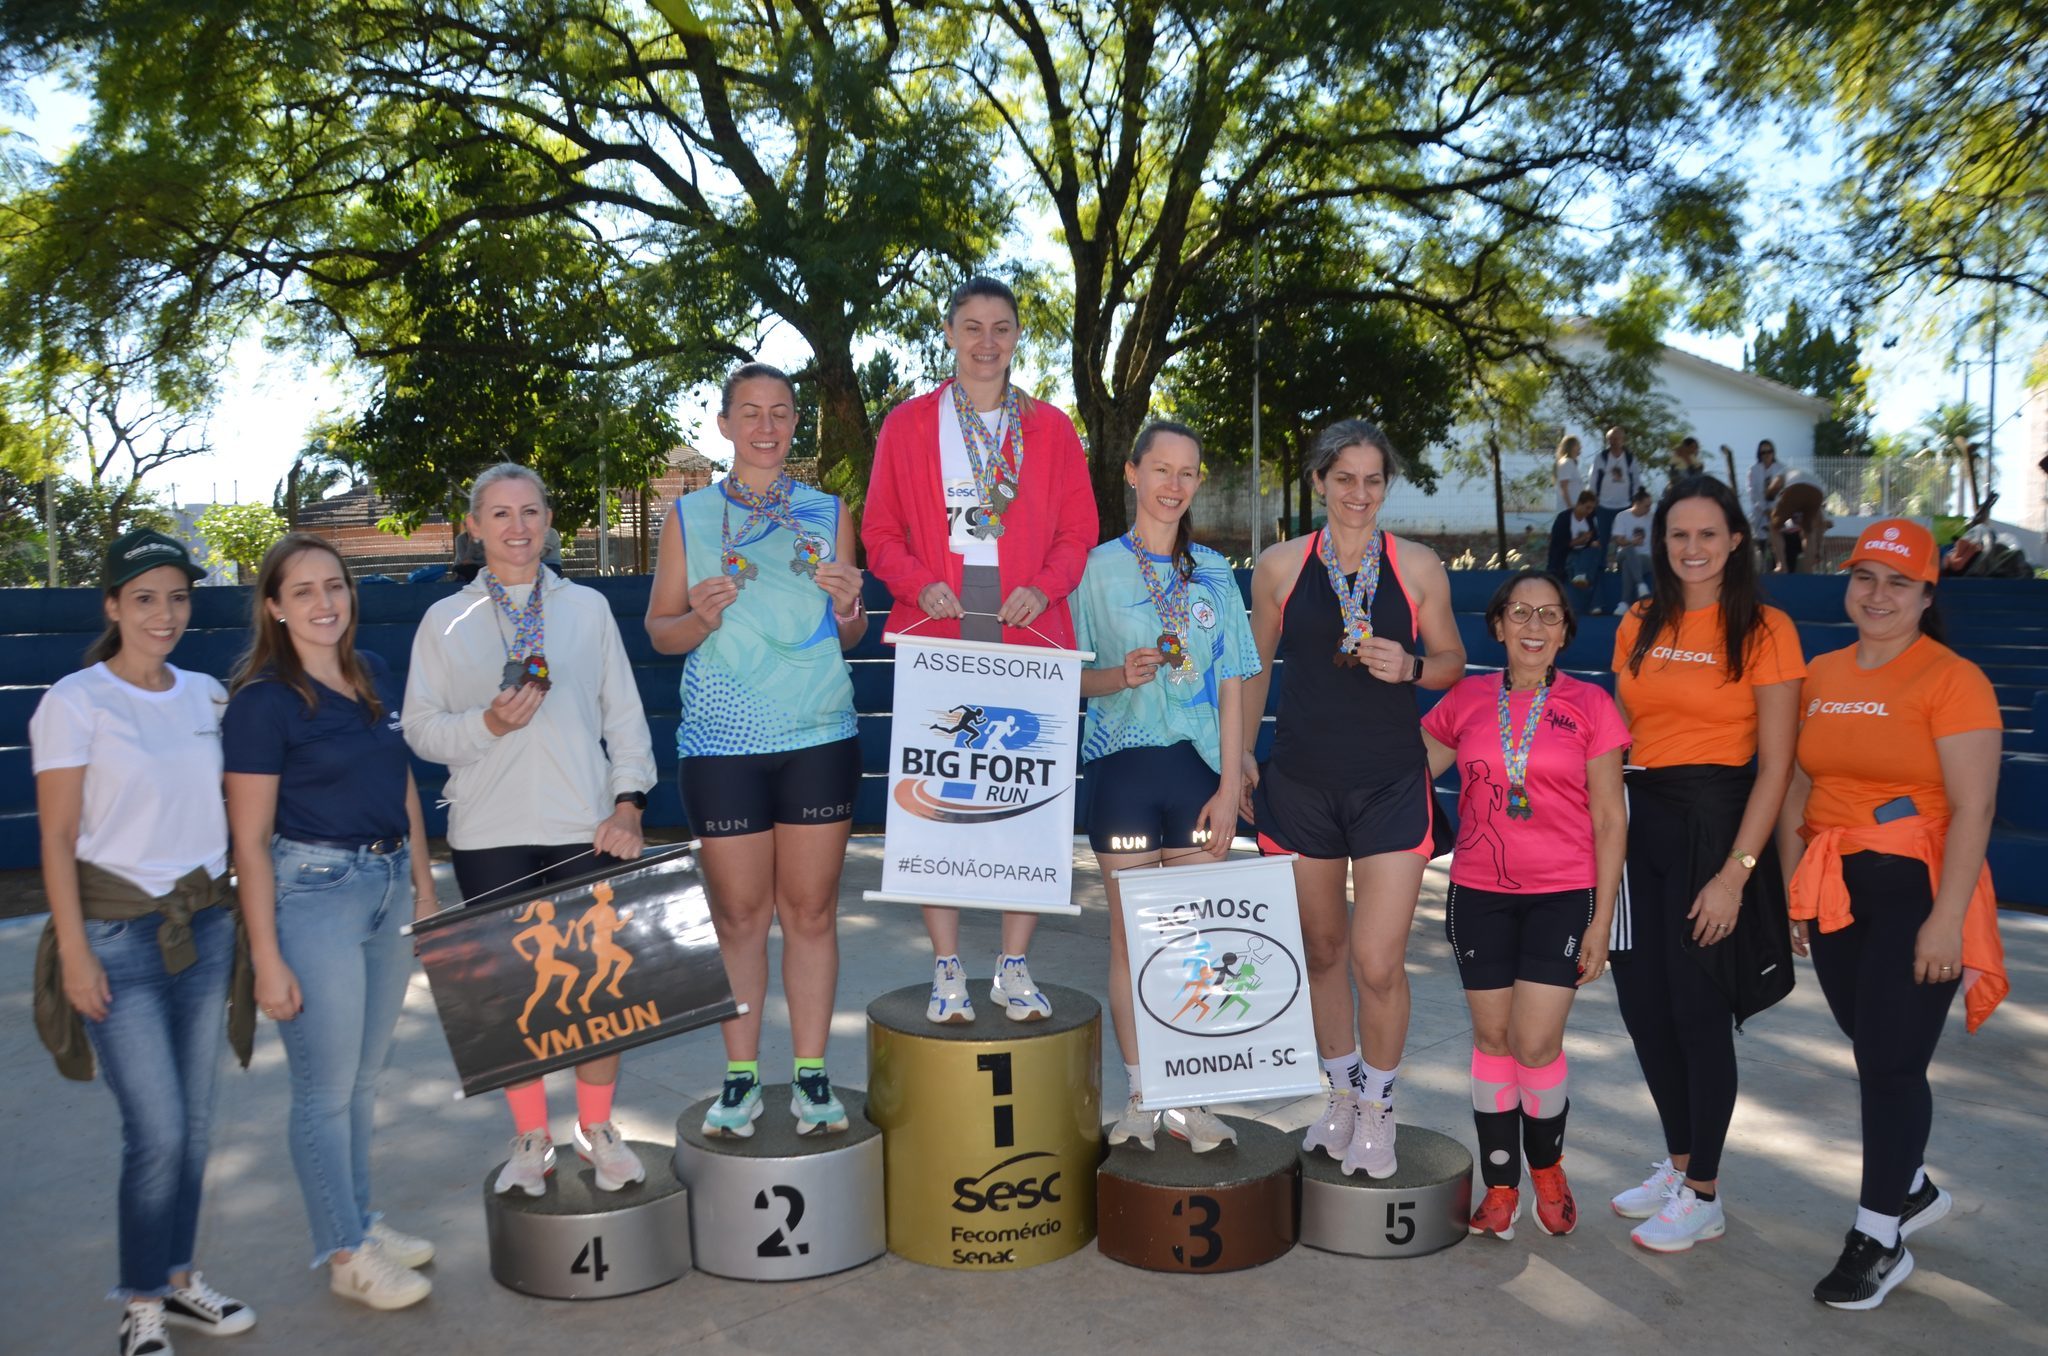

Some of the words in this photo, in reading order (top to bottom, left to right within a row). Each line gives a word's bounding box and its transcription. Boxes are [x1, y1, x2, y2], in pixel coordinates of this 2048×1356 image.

[1864, 540, 1911, 557] CRESOL
[913, 652, 1064, 681] ASSESSORIA
[1651, 646, 1717, 664] CRESOL
[1820, 701, 1889, 716] CRESOL
[901, 747, 959, 778] BIG
[970, 753, 1056, 787] FORT
[986, 785, 1029, 804] RUN
[705, 818, 748, 832] RUN
[802, 803, 851, 819] MORE
[1111, 836, 1147, 849] RUN
[898, 855, 1057, 883] #ÉSÓNÃOPARAR
[523, 1026, 584, 1061] VM
[586, 1000, 662, 1045] RUN
[1165, 1047, 1253, 1078] MONDAÍ
[1272, 1048, 1297, 1067] SC
[977, 1052, 1014, 1148] 1
[952, 1170, 1061, 1213] Sesc
[754, 1184, 809, 1257] 2
[951, 1218, 1061, 1243] Fecomércio
[1171, 1195, 1223, 1268] 3
[1384, 1201, 1416, 1246] 5
[570, 1236, 609, 1282] 4
[953, 1248, 1015, 1264] Senac
